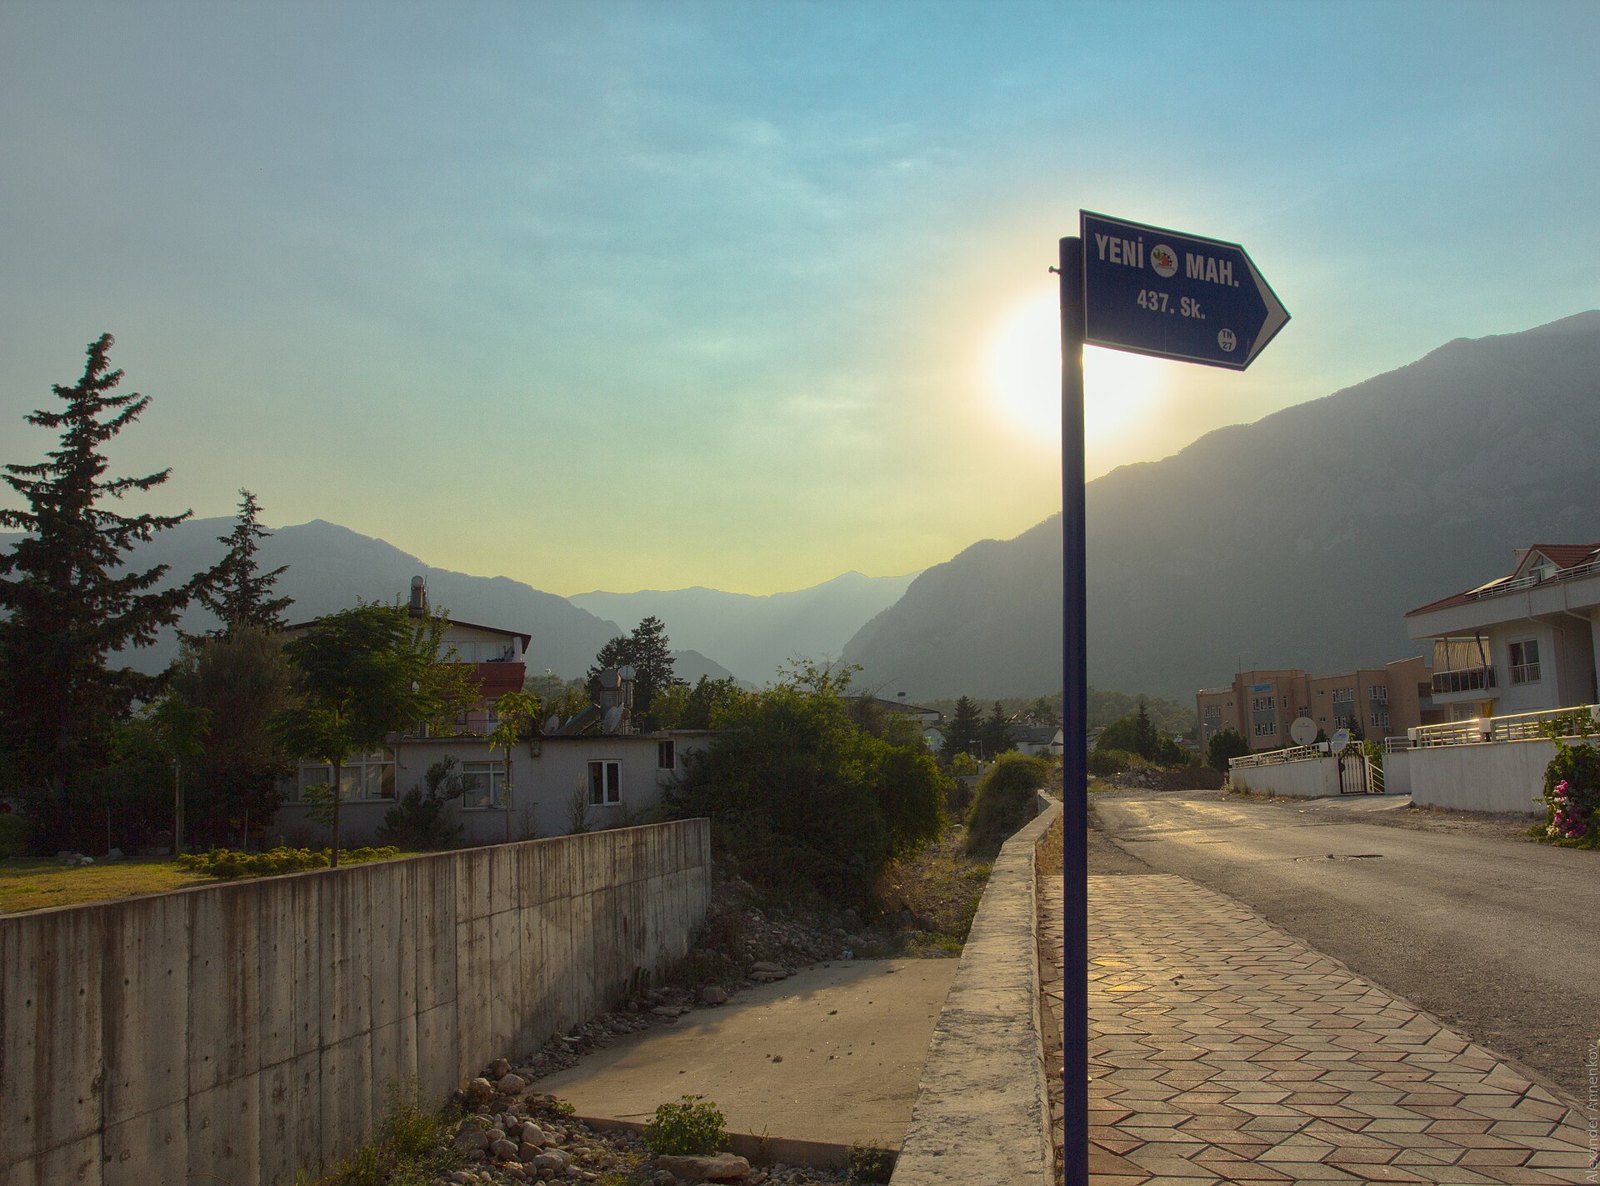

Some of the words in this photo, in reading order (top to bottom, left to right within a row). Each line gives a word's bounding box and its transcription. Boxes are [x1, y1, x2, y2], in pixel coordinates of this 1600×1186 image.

[1095, 233, 1144, 268] YENİ
[1185, 252, 1239, 287] MAH.
[1137, 289, 1175, 314] 437.
[1180, 296, 1206, 320] Sk.
